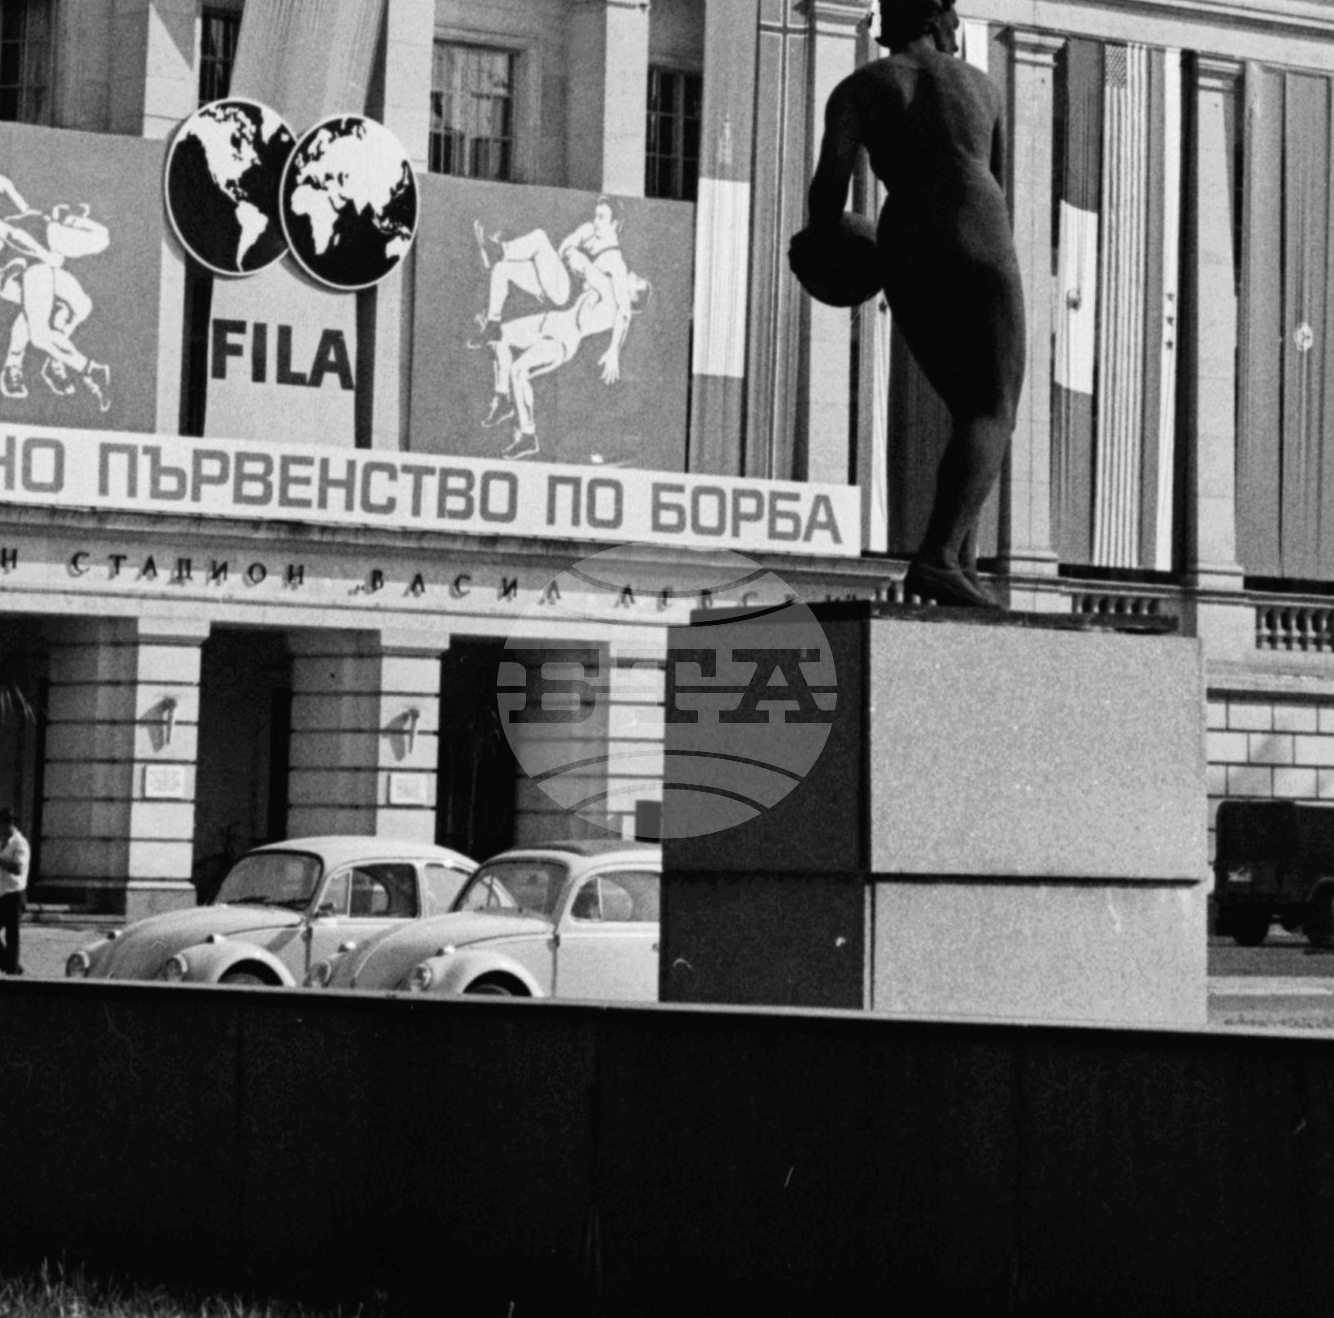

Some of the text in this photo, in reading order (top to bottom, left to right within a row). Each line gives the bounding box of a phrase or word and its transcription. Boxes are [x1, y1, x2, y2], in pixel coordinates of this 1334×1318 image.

[211, 318, 355, 390] FILA
[98, 442, 519, 523] ПЪРВЕНСТВО
[547, 474, 624, 530] ПО
[651, 482, 844, 546] БОРБА
[70, 550, 305, 586] СТАДИОН
